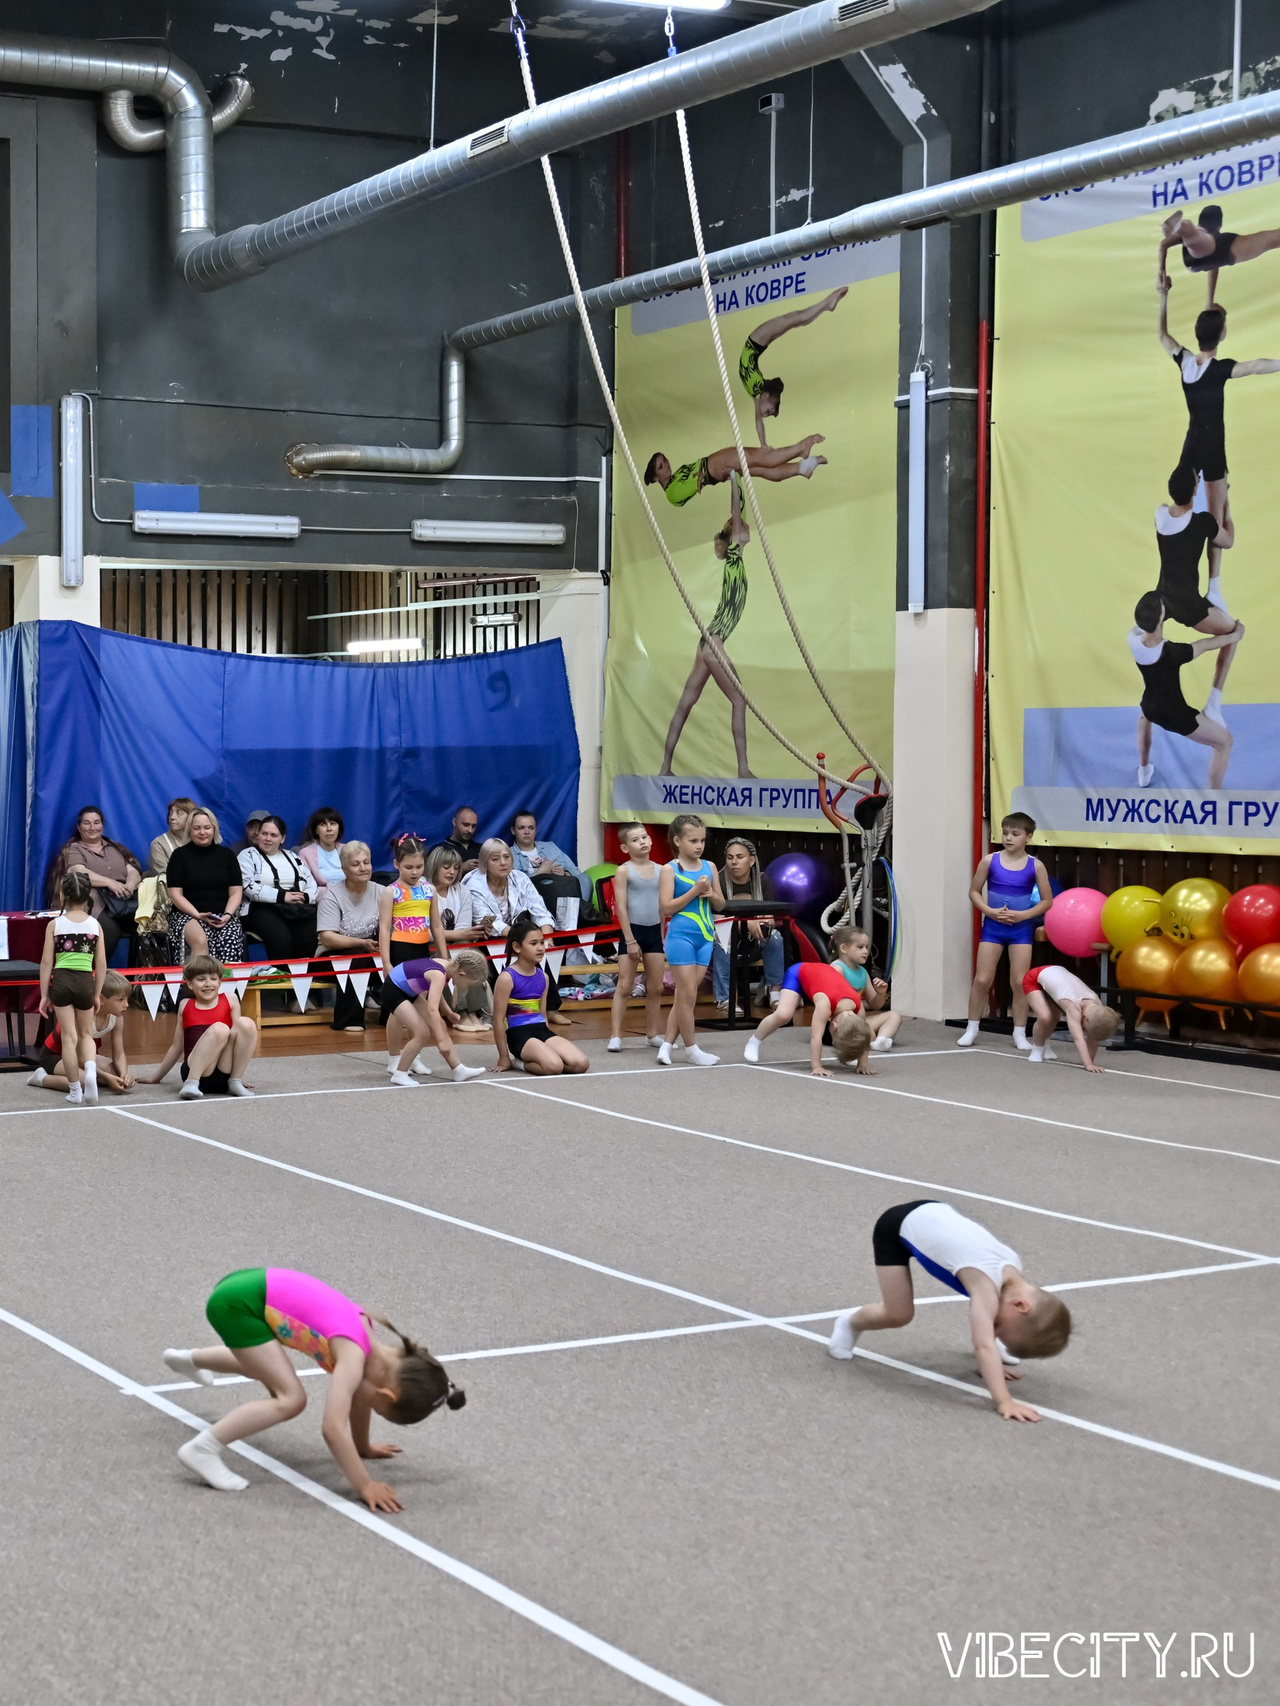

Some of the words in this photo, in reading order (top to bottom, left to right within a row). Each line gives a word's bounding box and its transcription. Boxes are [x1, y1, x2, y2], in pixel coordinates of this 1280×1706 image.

[1152, 178, 1189, 208] НА
[1198, 152, 1280, 198] КОВР
[715, 289, 740, 314] НА
[745, 271, 807, 307] КОВРЕ
[662, 784, 752, 807] ЖЕНСКАЯ
[1085, 797, 1217, 825] МУЖСКАЯ
[1228, 800, 1280, 827] ГРУ
